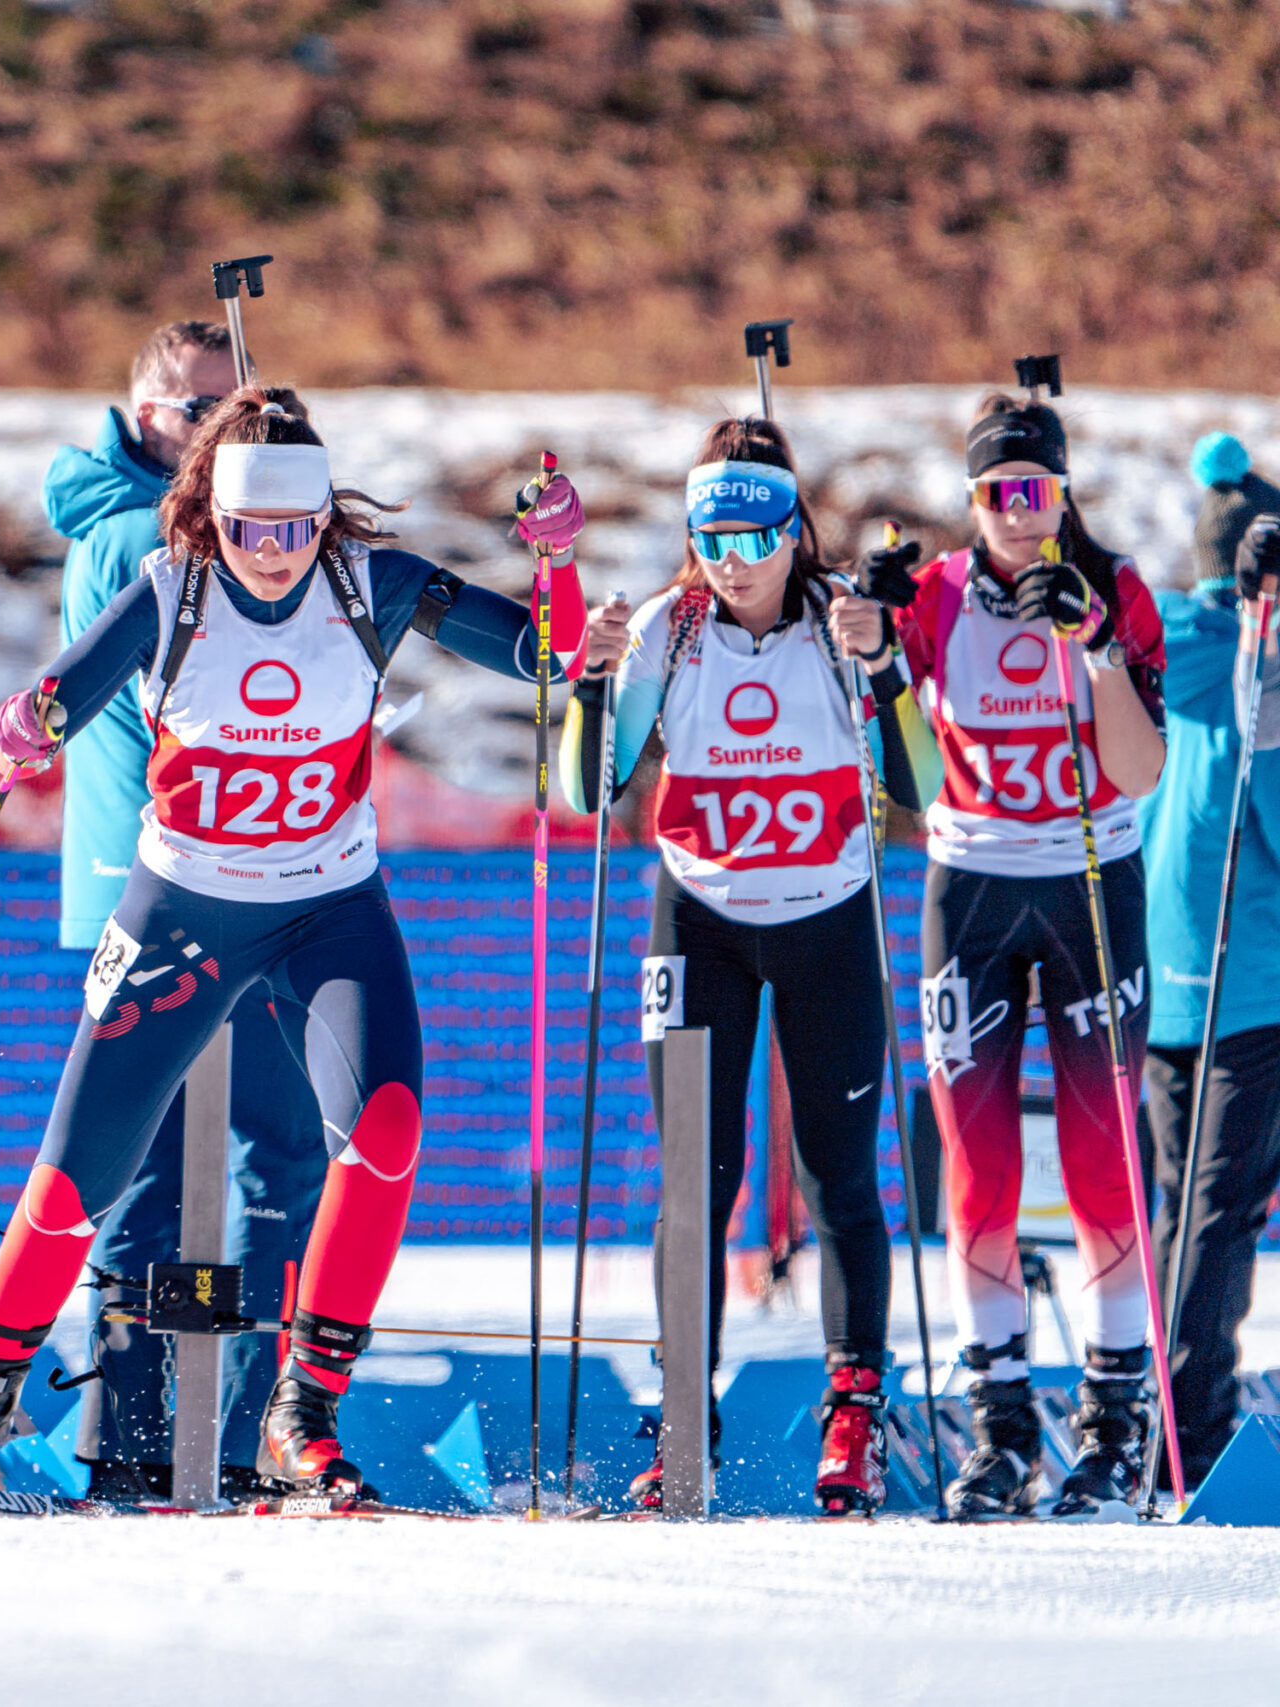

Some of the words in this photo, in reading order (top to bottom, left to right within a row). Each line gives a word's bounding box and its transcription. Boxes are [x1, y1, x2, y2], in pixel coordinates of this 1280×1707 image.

[538, 605, 550, 660] LEKI
[978, 693, 1067, 717] Sunrise
[219, 723, 321, 743] Sunrise
[708, 745, 803, 766] Sunrise
[964, 743, 1098, 813] 130
[191, 761, 336, 834] 128
[692, 790, 825, 858] 129
[218, 865, 264, 880] RAIFFEISEN
[279, 867, 313, 880] helvetia
[924, 987, 957, 1035] 30
[1064, 965, 1145, 1037] TSV
[281, 1498, 333, 1515] ROSSIGNOL
